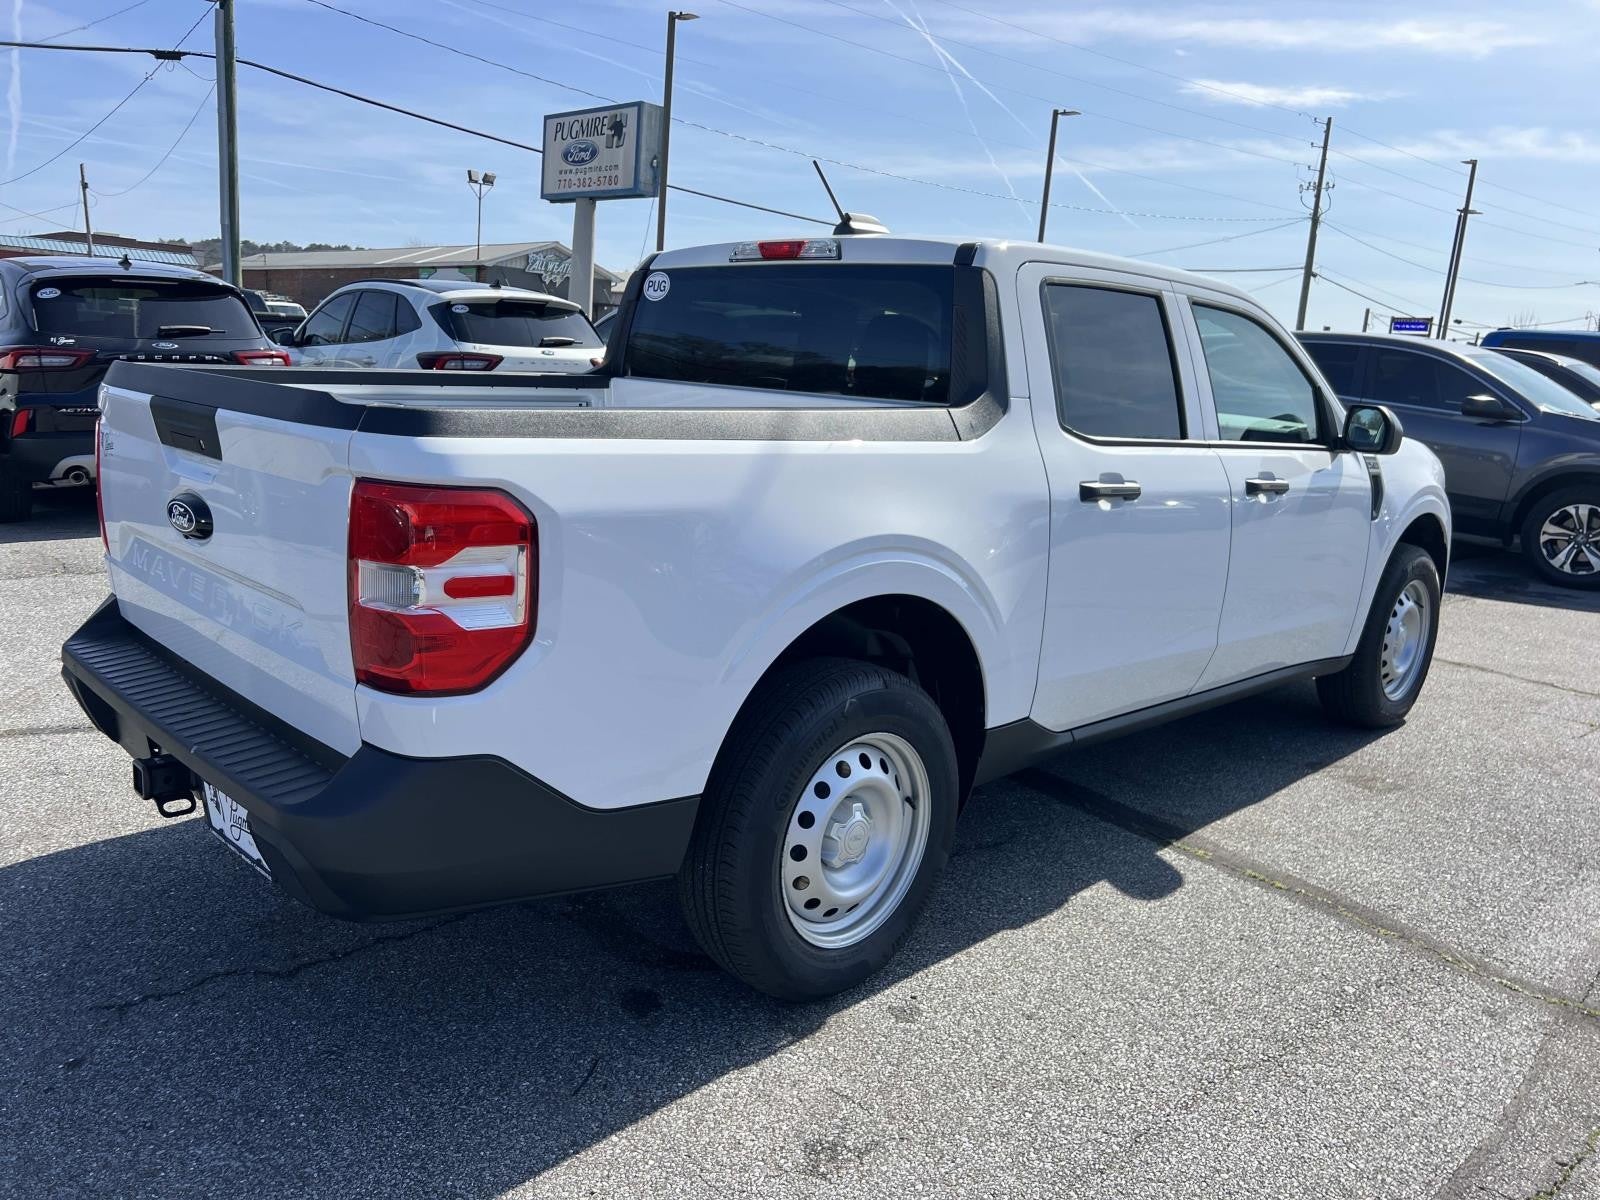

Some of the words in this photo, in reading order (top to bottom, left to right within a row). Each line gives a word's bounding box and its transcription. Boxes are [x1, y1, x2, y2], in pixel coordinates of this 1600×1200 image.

[554, 116, 608, 142] PUGMIRE
[567, 144, 592, 162] Ford
[558, 163, 619, 175] www.pugmire.com
[557, 175, 619, 190] 770-382-5780
[647, 280, 667, 292] PUG
[171, 504, 189, 528] Ford
[131, 544, 304, 638] MAVERICK
